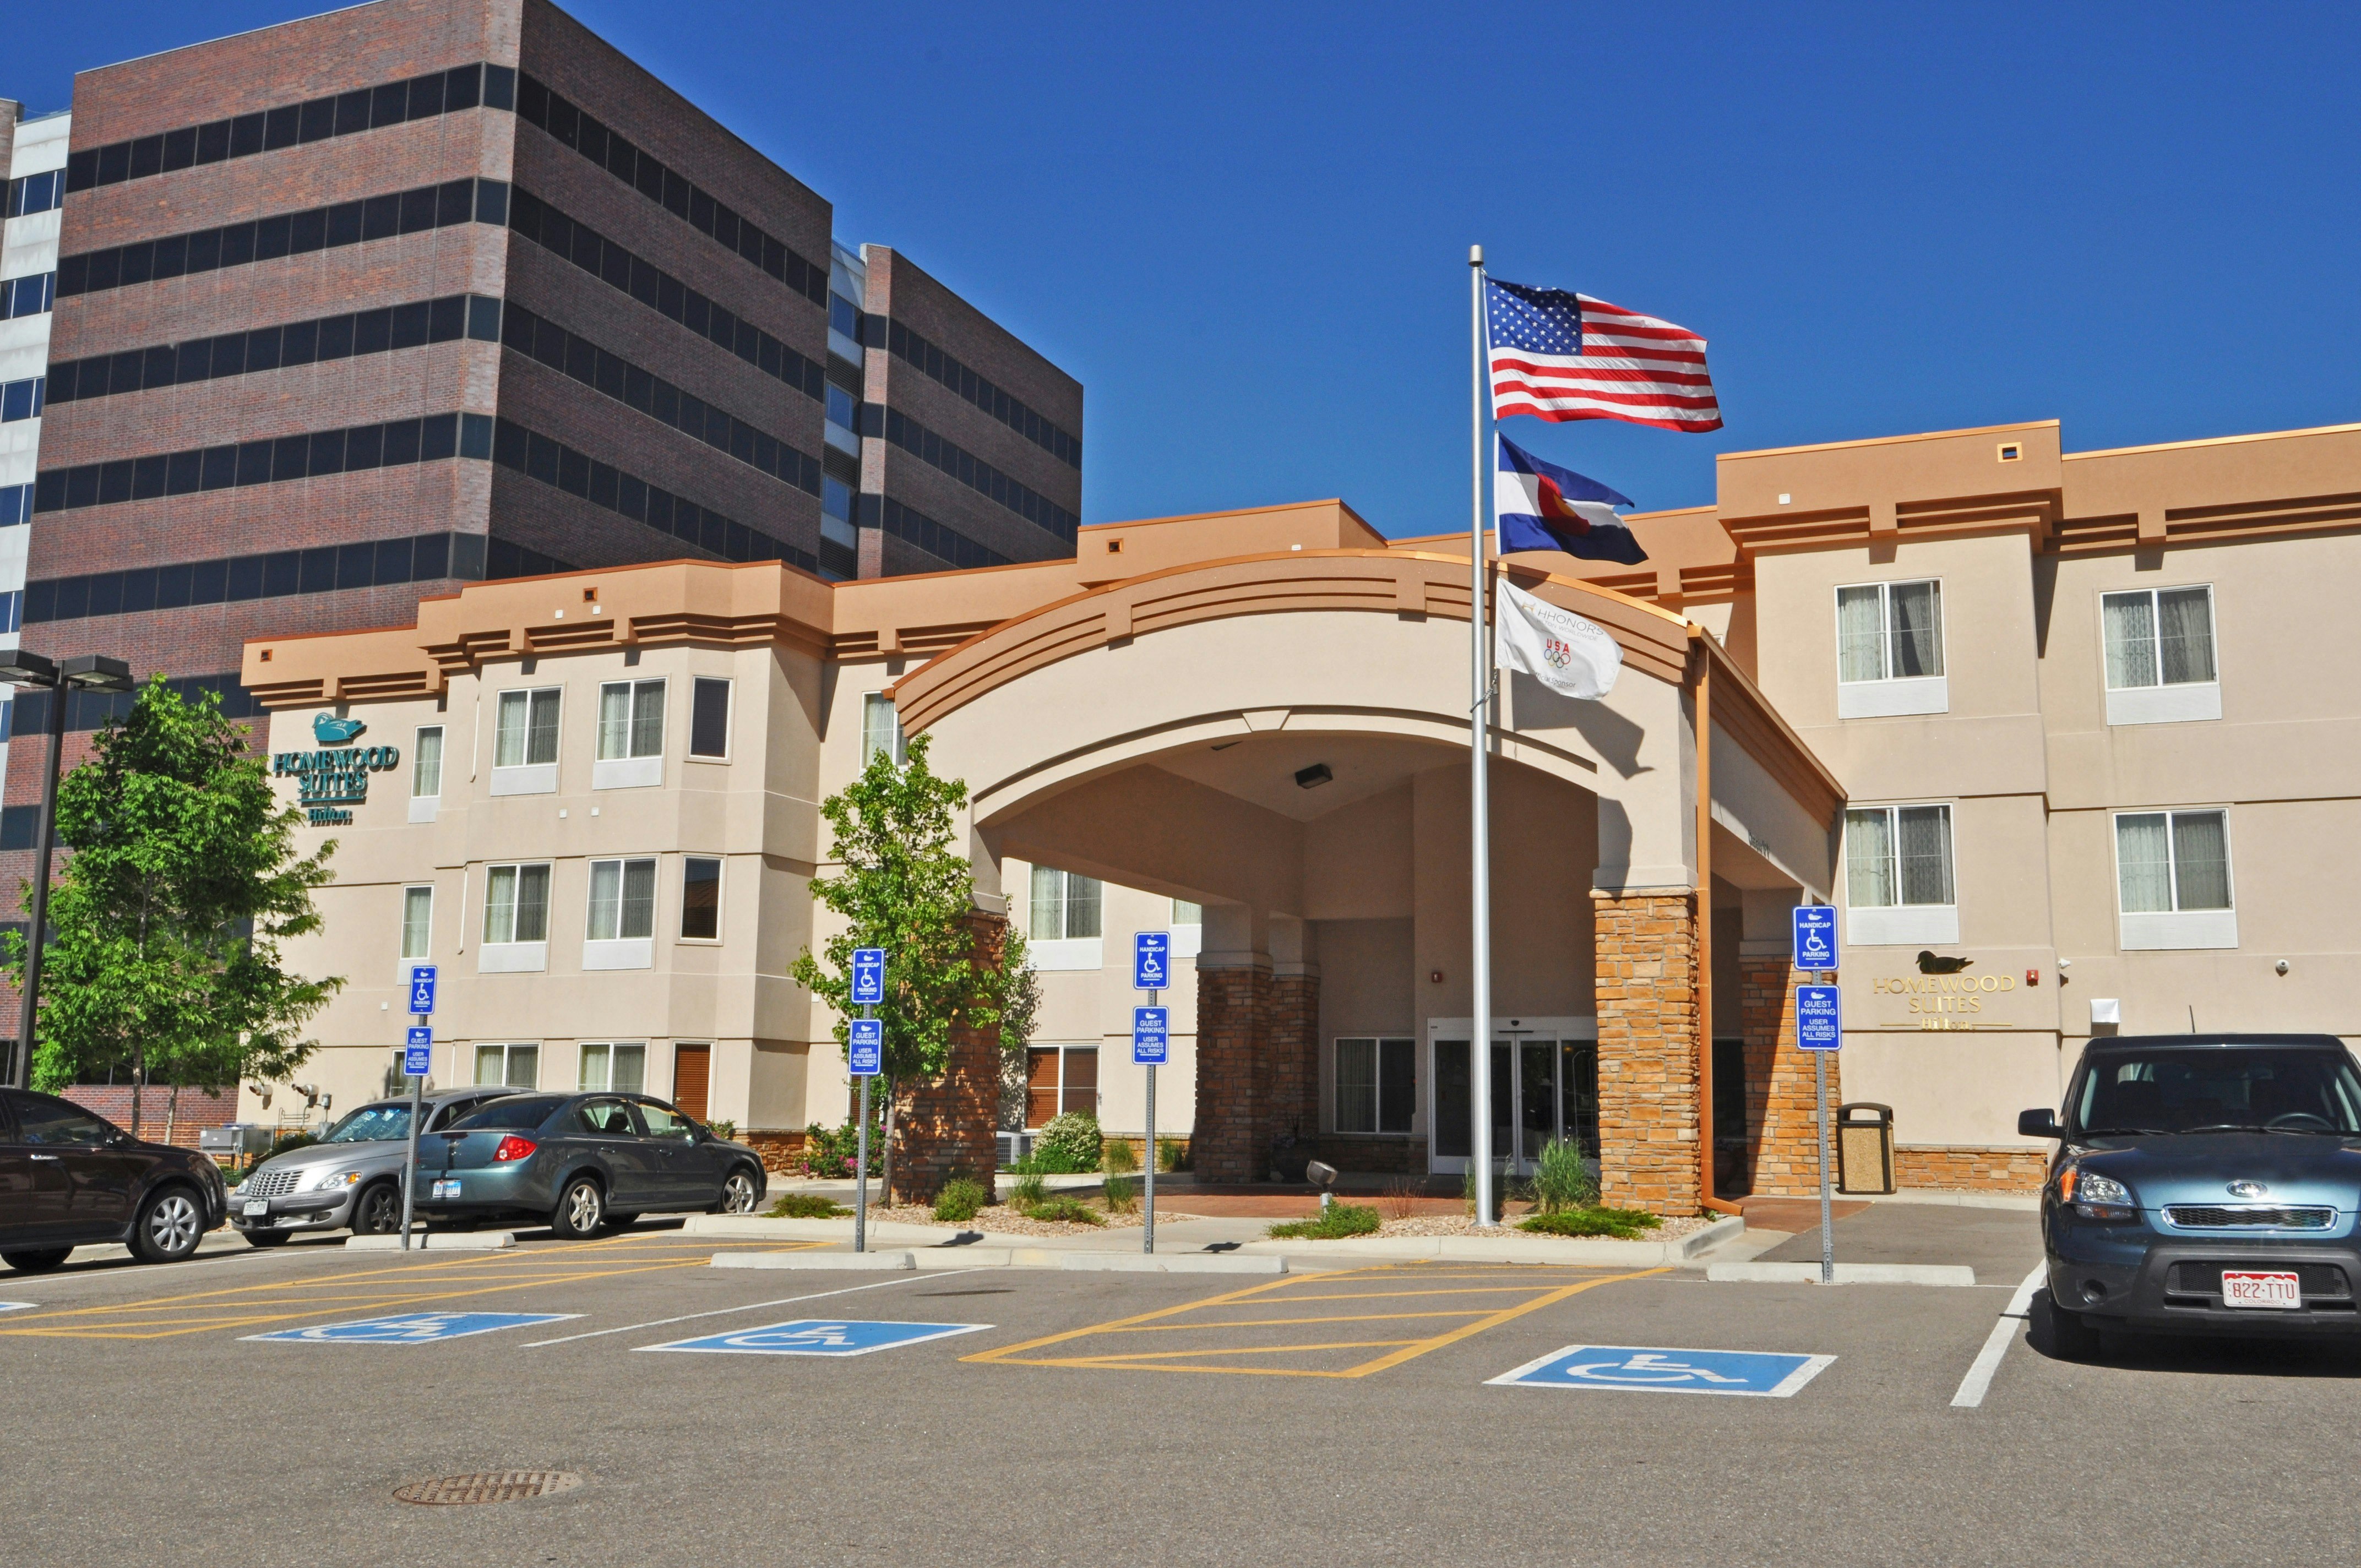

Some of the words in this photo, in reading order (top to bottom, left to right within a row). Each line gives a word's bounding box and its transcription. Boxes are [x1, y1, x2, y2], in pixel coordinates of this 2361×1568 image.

[1538, 608, 1604, 635] HHONORS
[1551, 677, 1576, 688] Sponsor
[273, 746, 400, 772] HOMEWOOD
[297, 771, 368, 793] SUITES
[308, 807, 350, 821] Hilton
[1873, 975, 2015, 994] HOMEWOOD
[1908, 995, 1981, 1013] SUITES
[1921, 1016, 1970, 1030] Hilton
